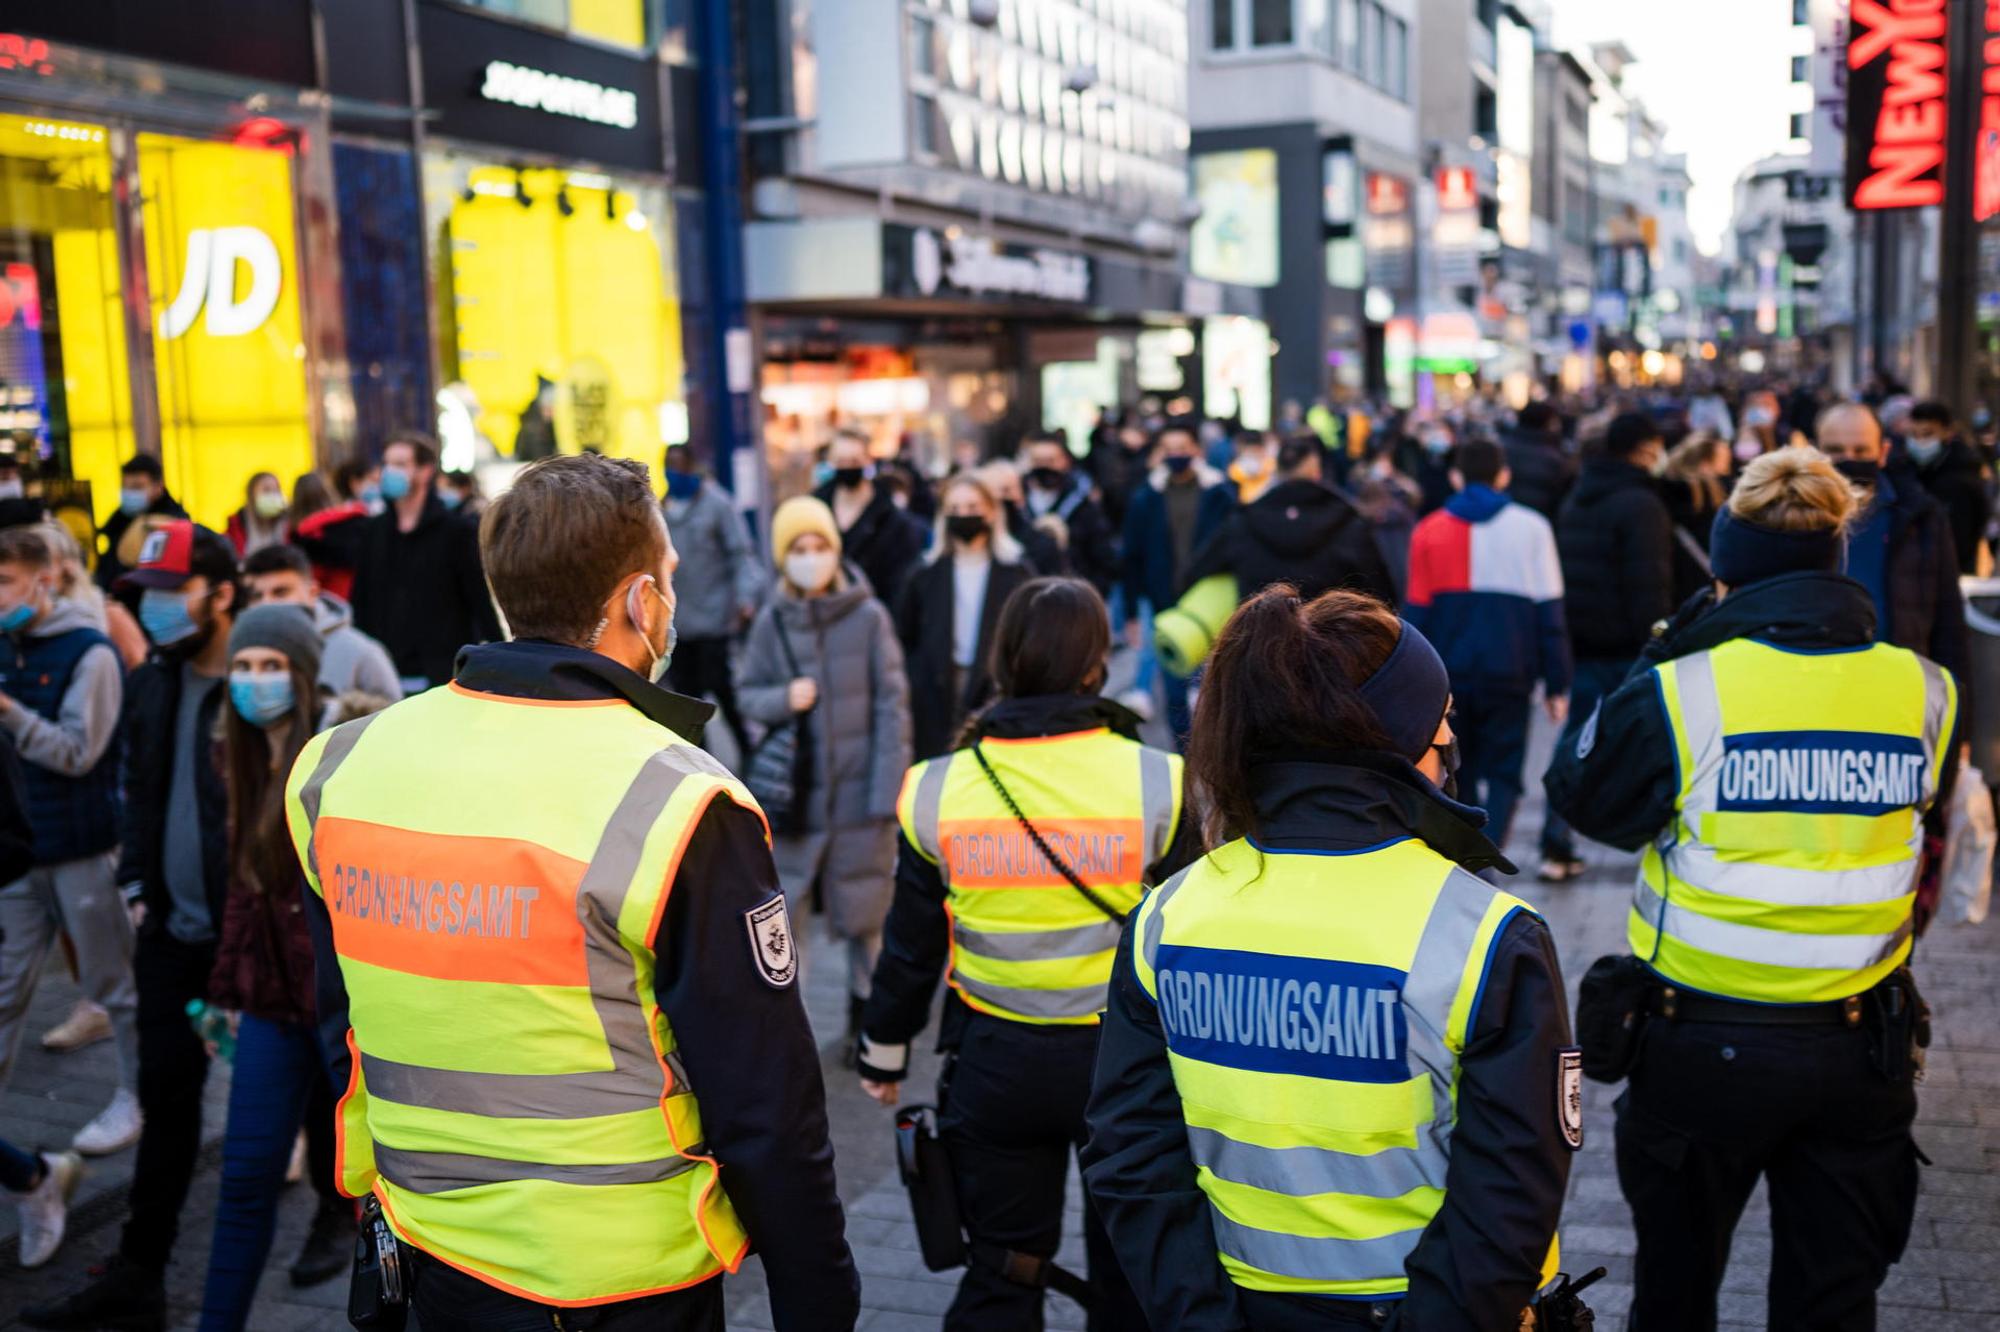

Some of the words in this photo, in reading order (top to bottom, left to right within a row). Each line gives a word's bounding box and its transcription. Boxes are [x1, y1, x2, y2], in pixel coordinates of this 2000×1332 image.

[158, 226, 282, 340] JD
[1721, 748, 1924, 805] ORDNUNGSAMT
[333, 863, 540, 939] ORDNUNGSAMT
[1158, 969, 1398, 1060] ORDNUNGSAMT
